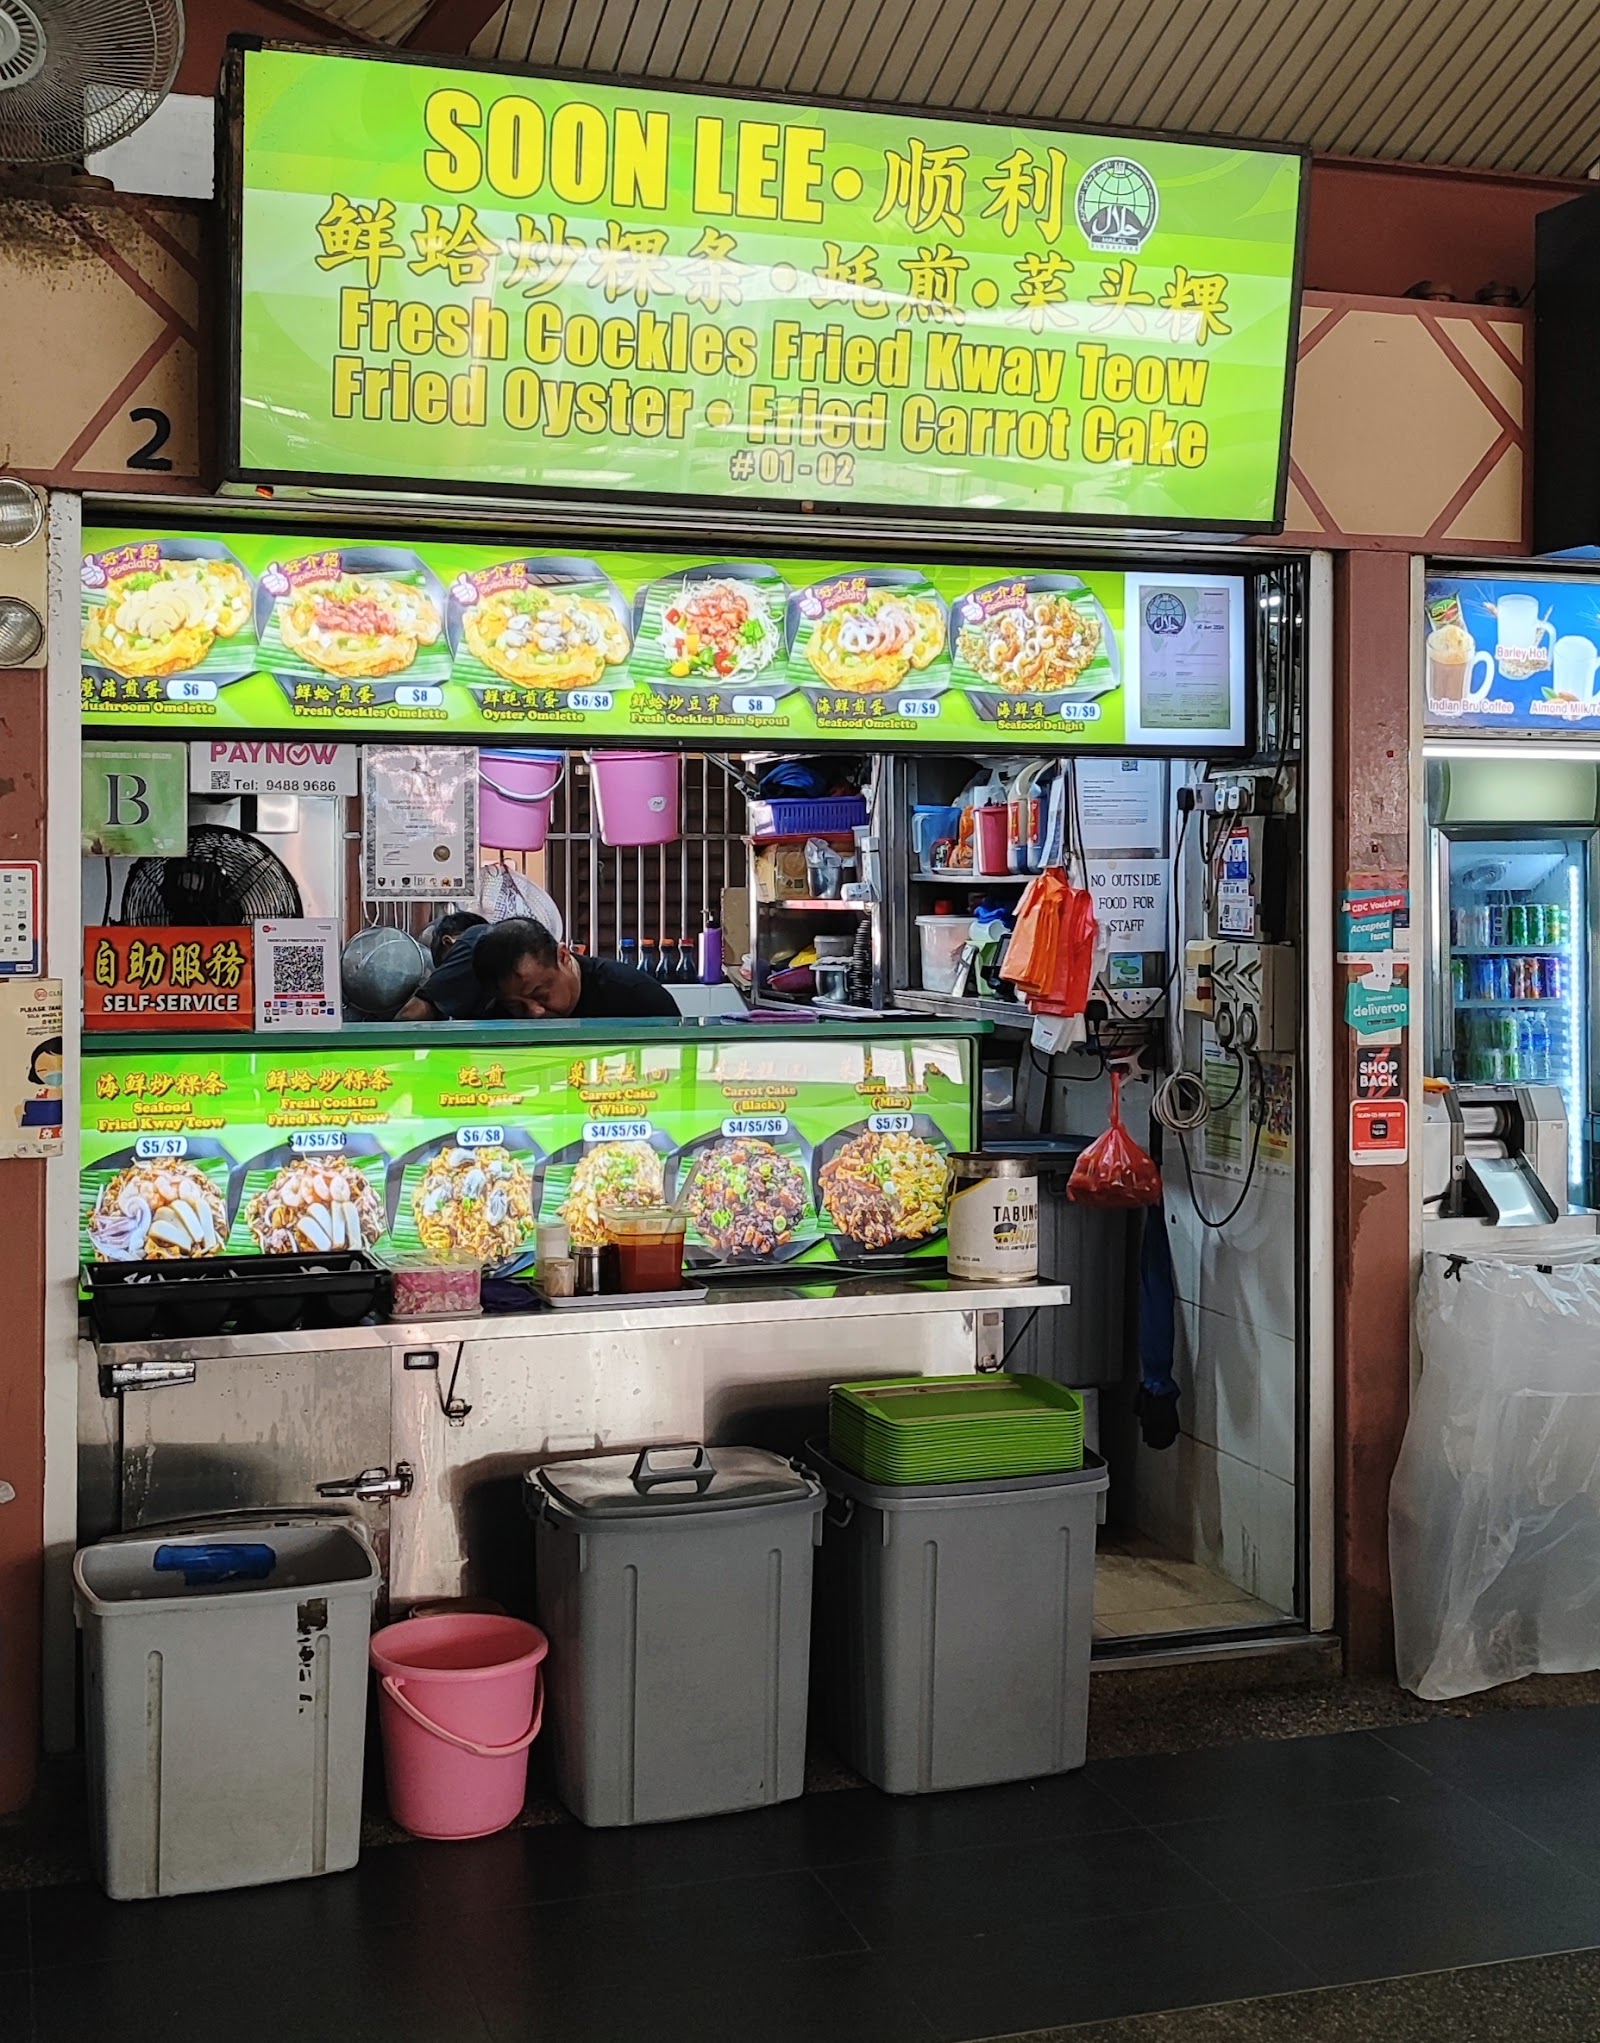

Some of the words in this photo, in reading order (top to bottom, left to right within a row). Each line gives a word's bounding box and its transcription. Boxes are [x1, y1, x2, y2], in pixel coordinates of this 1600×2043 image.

[423, 88, 671, 210] SOON
[693, 115, 826, 224] LEE
[875, 137, 1068, 244] 顺利
[314, 192, 757, 314] 鲜蛤炒粿条
[809, 241, 969, 327] 蚝煎
[1004, 251, 1233, 347] 菜头粿
[339, 287, 508, 360] Fresh
[524, 301, 758, 379] Cockles
[771, 320, 913, 389] Fried
[925, 331, 1066, 403] Kway
[1076, 342, 1209, 408] Teow
[332, 355, 489, 428] Fried
[503, 366, 694, 439] Oyster
[748, 384, 888, 453] Fried
[900, 395, 1070, 462] Carrot
[1080, 405, 1209, 469] Cake
[126, 407, 173, 471] 2
[1497, 647, 1528, 661] Barley
[1529, 648, 1546, 658] Hot
[183, 683, 199, 696] $6
[412, 689, 428, 701] $8
[153, 702, 215, 713] Omelette
[573, 694, 609, 707] $6/$8
[748, 699, 762, 711] $8
[1430, 700, 1459, 711] Indian
[1462, 701, 1479, 711] Bru
[1482, 701, 1512, 712] Coffee
[1532, 702, 1568, 713] Almond
[294, 705, 332, 716] Fresh
[335, 706, 386, 717] Cockles
[388, 708, 448, 719] Omelette
[904, 702, 936, 714] $7/$9
[1066, 705, 1095, 717] $7/$9
[482, 709, 525, 722] Oyster
[527, 710, 585, 721] Omelette
[630, 712, 665, 723] Fresh
[667, 713, 713, 725] Cockles
[715, 714, 745, 725] Bean
[747, 715, 789, 727] Sprout
[817, 718, 863, 728] Seafood
[864, 718, 917, 729] Omelette
[997, 720, 1041, 730] Seafood
[1043, 720, 1084, 733] Delight
[210, 742, 338, 765] PAYNOW
[233, 779, 258, 791] Tel:
[266, 779, 299, 791] 9488
[303, 779, 336, 792] 9686
[104, 774, 150, 826] B
[1090, 874, 1106, 887] NO
[1112, 873, 1161, 887] OUTSIDE
[1098, 897, 1127, 910] FOOD
[1132, 896, 1155, 909] FOR
[1351, 903, 1369, 913] CDC
[1370, 899, 1401, 910] Voucher
[1110, 919, 1144, 932] STAFF
[1350, 920, 1390, 934] Accepted
[95, 940, 245, 988] 自助服務
[102, 994, 238, 1012] SELF-SERVICE
[1353, 1003, 1407, 1017] deliveroo
[1359, 1061, 1398, 1074] SHOP
[1360, 1074, 1398, 1087] BACK
[579, 1089, 623, 1102] Carrot
[624, 1088, 658, 1101] Cake
[721, 1085, 763, 1097] Carrot
[765, 1084, 798, 1096] Cake
[280, 1097, 320, 1110] Fresh
[322, 1096, 377, 1109] Cockles
[439, 1093, 477, 1107] Fried
[478, 1092, 523, 1108] Oyster
[132, 1101, 192, 1114] Seafood
[97, 1118, 138, 1131] Fried
[139, 1117, 183, 1131] Kway
[184, 1116, 226, 1128] Teow
[267, 1113, 305, 1127] Fried
[307, 1112, 349, 1126] Kway
[350, 1111, 390, 1124] Teow
[728, 1118, 782, 1134] $4/$5/$6
[875, 1116, 909, 1131] $5/$7
[463, 1129, 500, 1143] $6/$8
[591, 1122, 647, 1138] $4/$5/$6
[142, 1140, 182, 1154] $5/$7
[288, 1133, 347, 1148] $4/$5/$6
